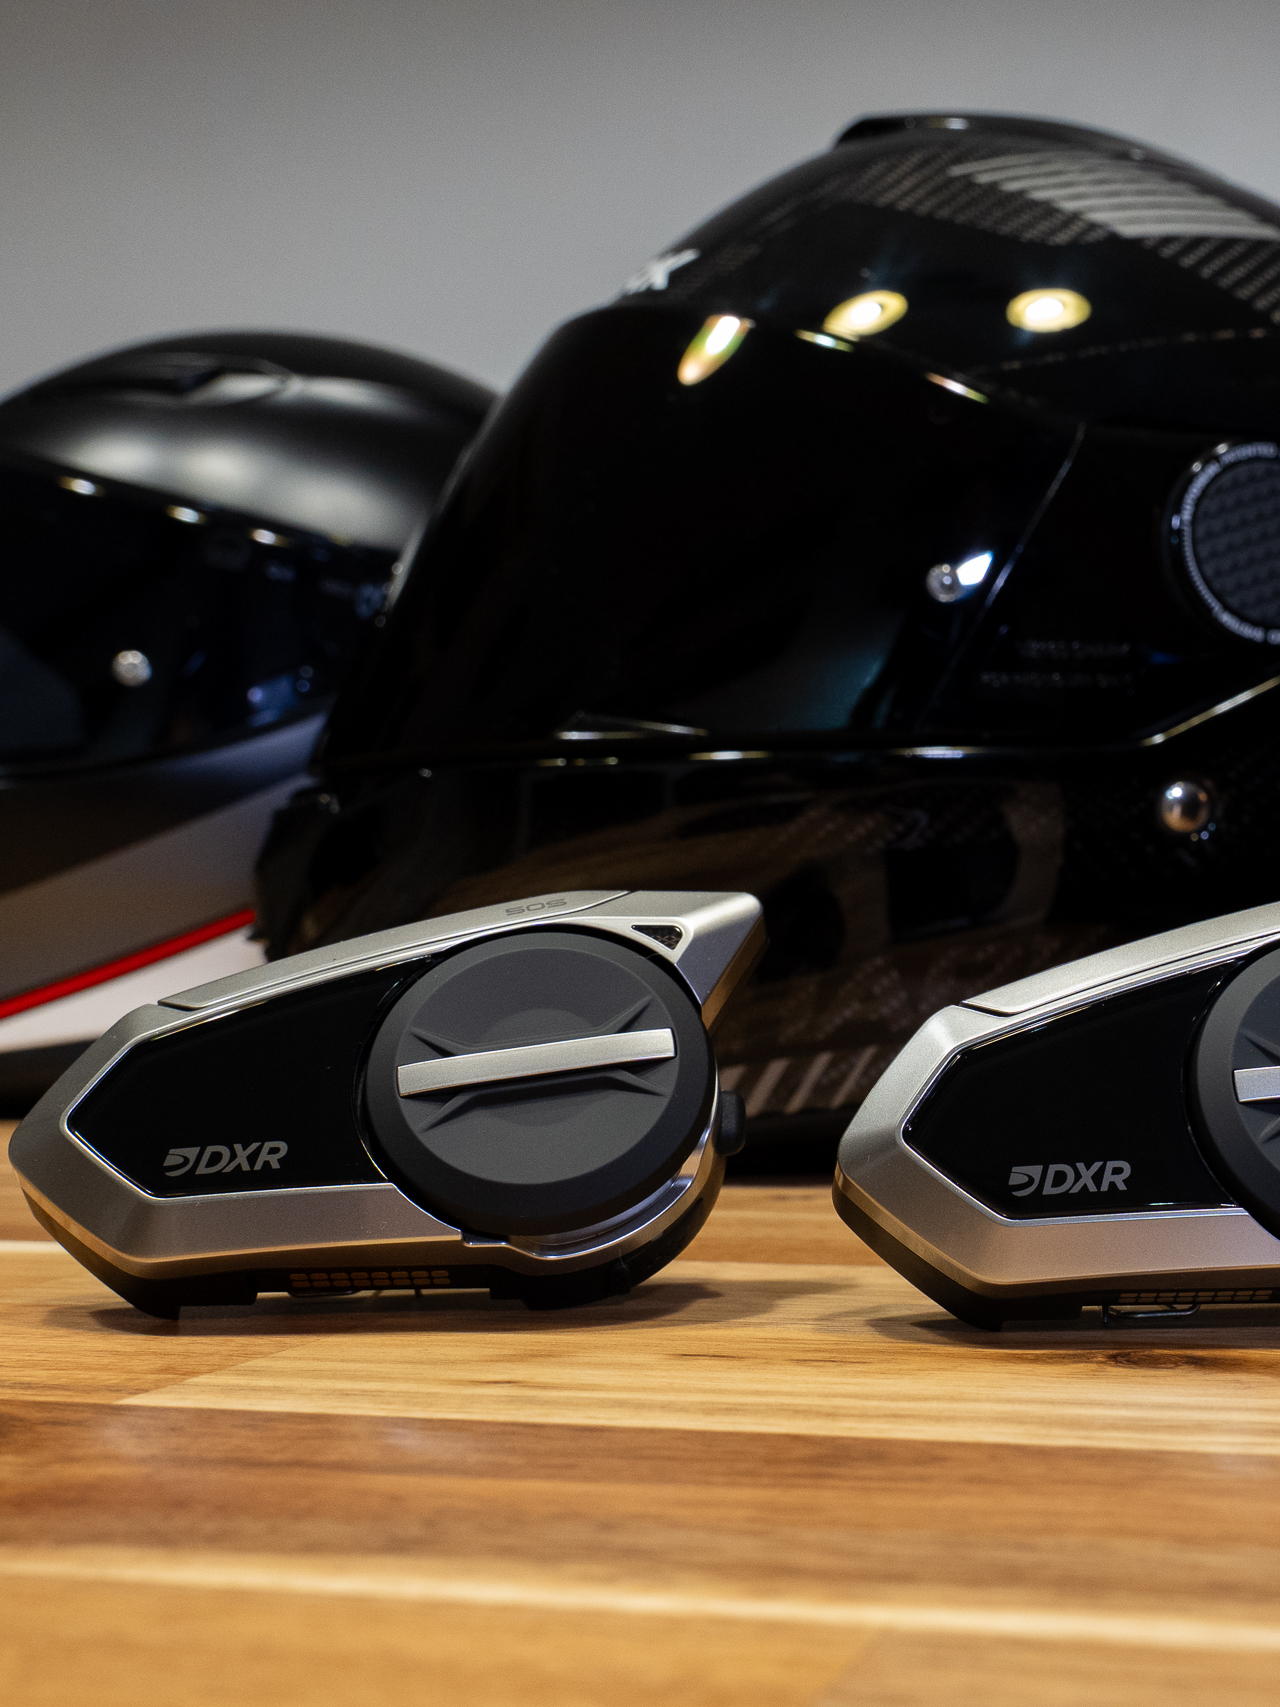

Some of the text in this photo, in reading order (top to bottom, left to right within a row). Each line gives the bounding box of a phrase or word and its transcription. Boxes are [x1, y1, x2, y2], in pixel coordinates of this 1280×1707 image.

[505, 898, 568, 916] 50S
[194, 1140, 289, 1175] DXR
[1041, 1160, 1132, 1196] DXR
